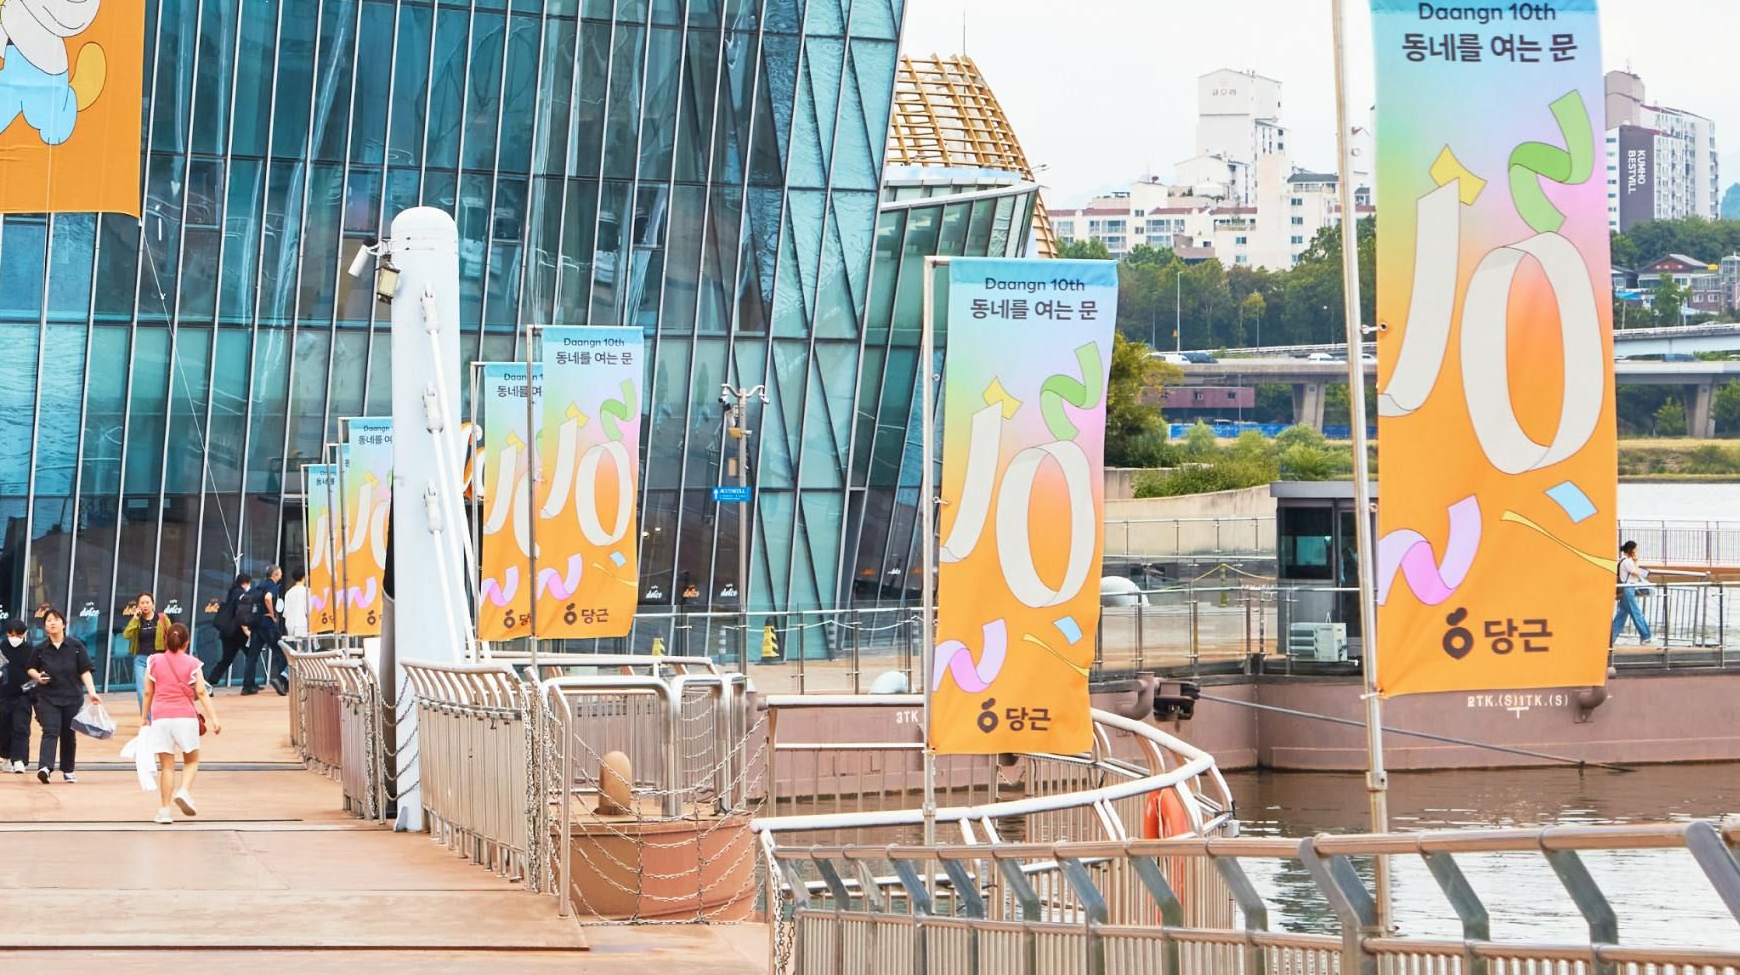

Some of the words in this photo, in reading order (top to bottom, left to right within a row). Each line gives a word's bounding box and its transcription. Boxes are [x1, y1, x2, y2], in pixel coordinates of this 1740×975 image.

[1418, 2, 1503, 24] Daangn
[1508, 2, 1556, 21] 10th
[1402, 33, 1483, 63] 동네를
[1491, 33, 1542, 63] 여는
[1549, 33, 1578, 62] 문
[1638, 150, 1646, 185] KUMHO
[985, 277, 1046, 293] Daangn
[1050, 278, 1085, 291] 10th
[970, 299, 1029, 320] 동네를
[1035, 300, 1074, 321] 여는
[1078, 300, 1098, 321] 문
[563, 338, 601, 348] Daangn
[603, 338, 625, 347] 10th
[555, 352, 591, 365] 동네를
[595, 352, 617, 365] 여는
[621, 352, 633, 365] 문
[504, 373, 538, 381] Daann
[532, 386, 542, 397] 여
[581, 608, 609, 624] 당근
[1484, 618, 1553, 655] 당근
[1006, 707, 1051, 732] 당근
